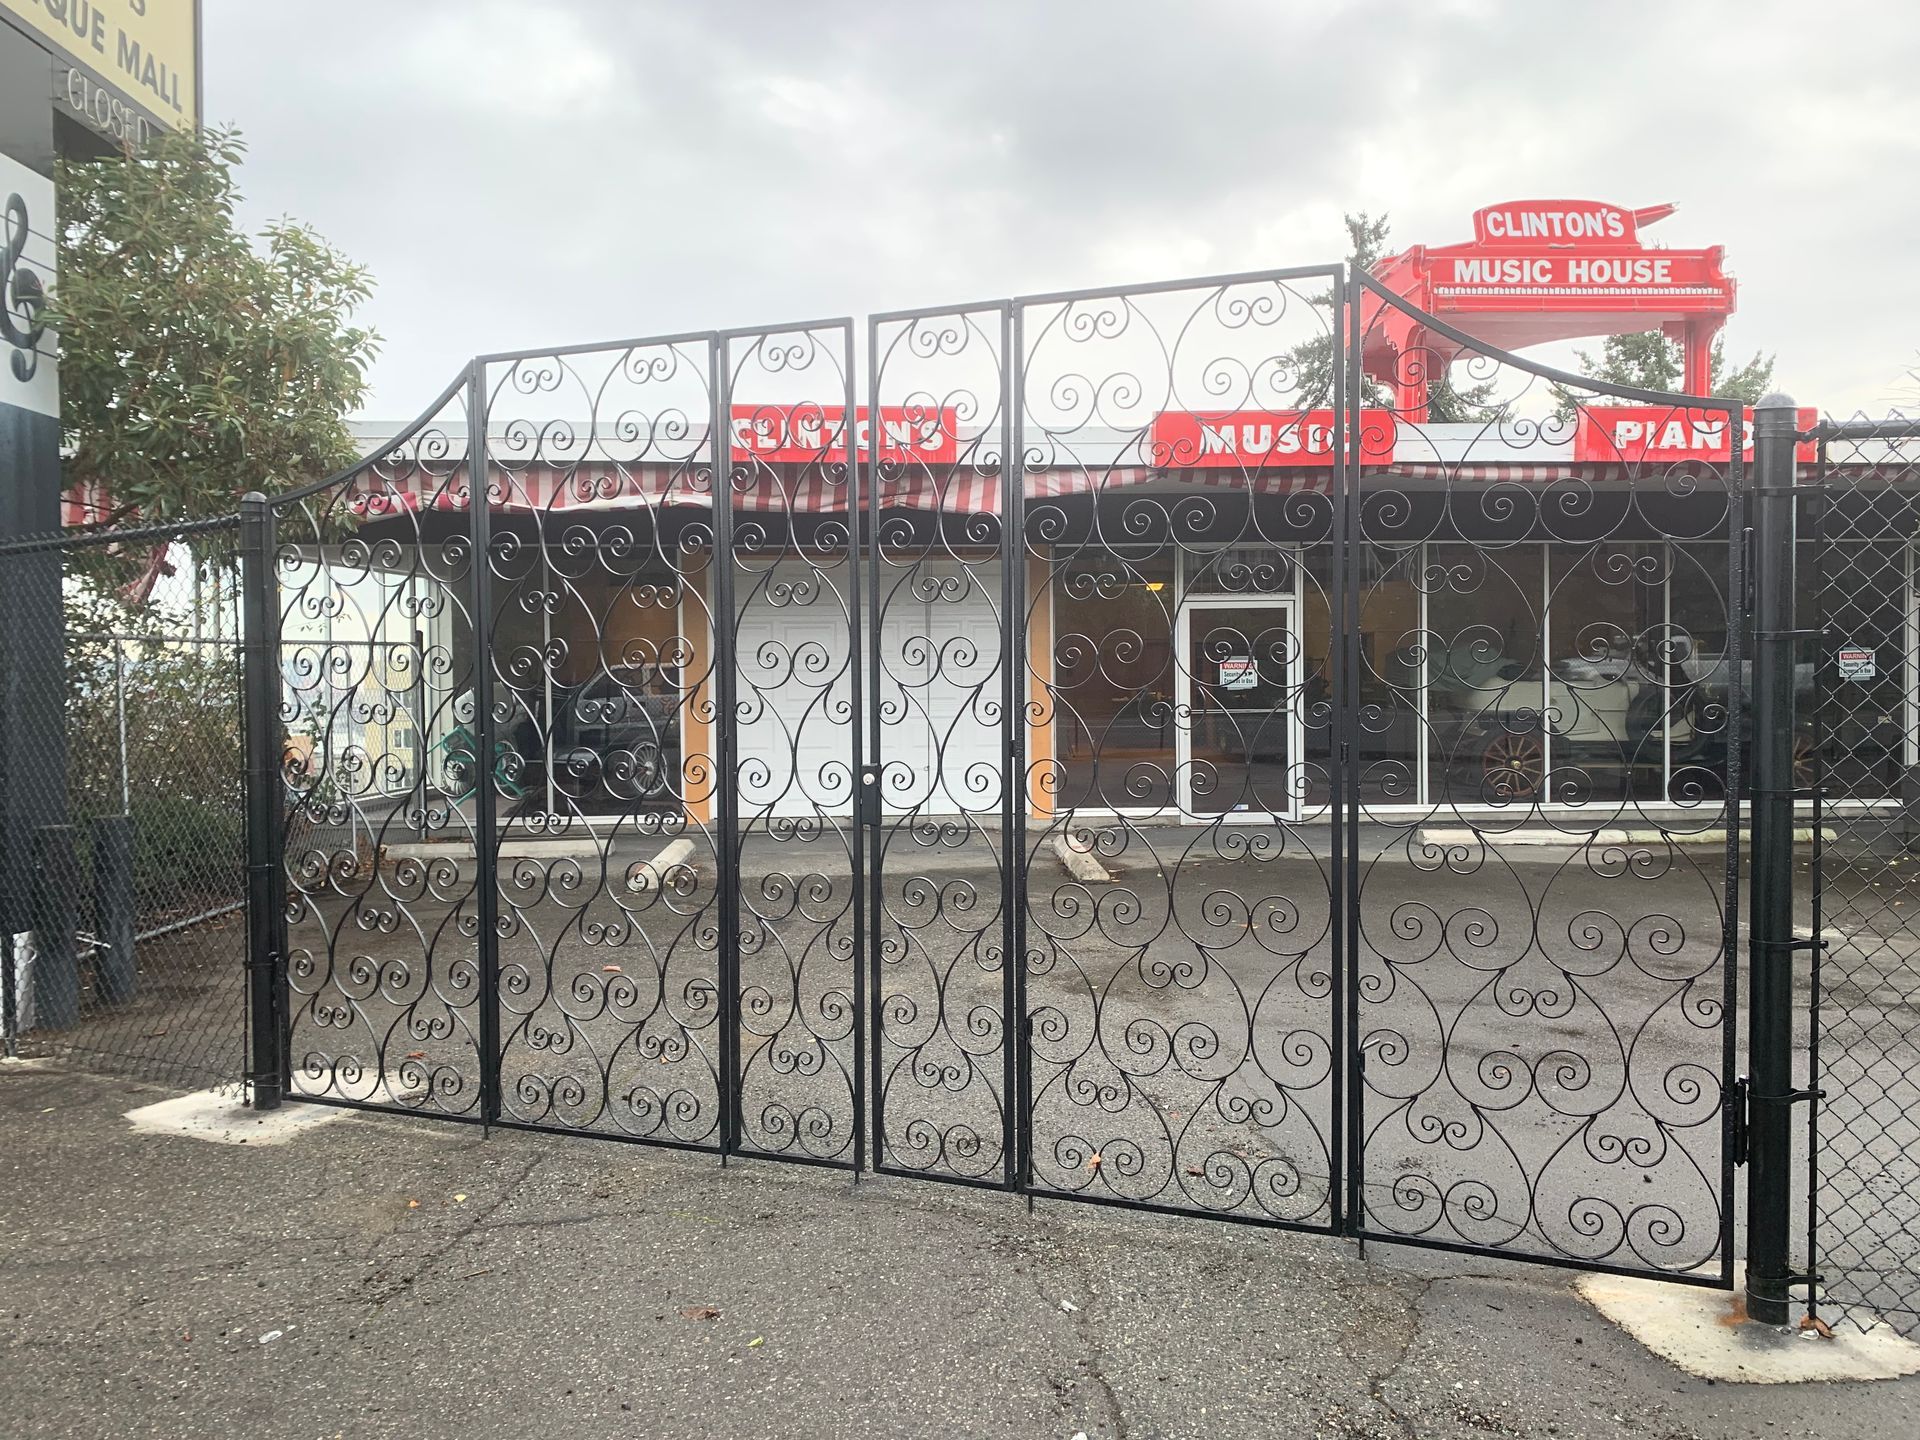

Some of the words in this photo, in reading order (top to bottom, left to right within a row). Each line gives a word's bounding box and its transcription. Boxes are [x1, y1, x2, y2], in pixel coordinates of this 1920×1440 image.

[32, 0, 105, 54] QUE
[117, 28, 183, 114] MALL
[67, 67, 149, 155] CLOSED
[1486, 208, 1625, 238] CLINTON'S
[1454, 259, 1553, 283] MUSIC
[1568, 259, 1672, 283] HOUSE
[730, 415, 944, 451] CLINTON'S
